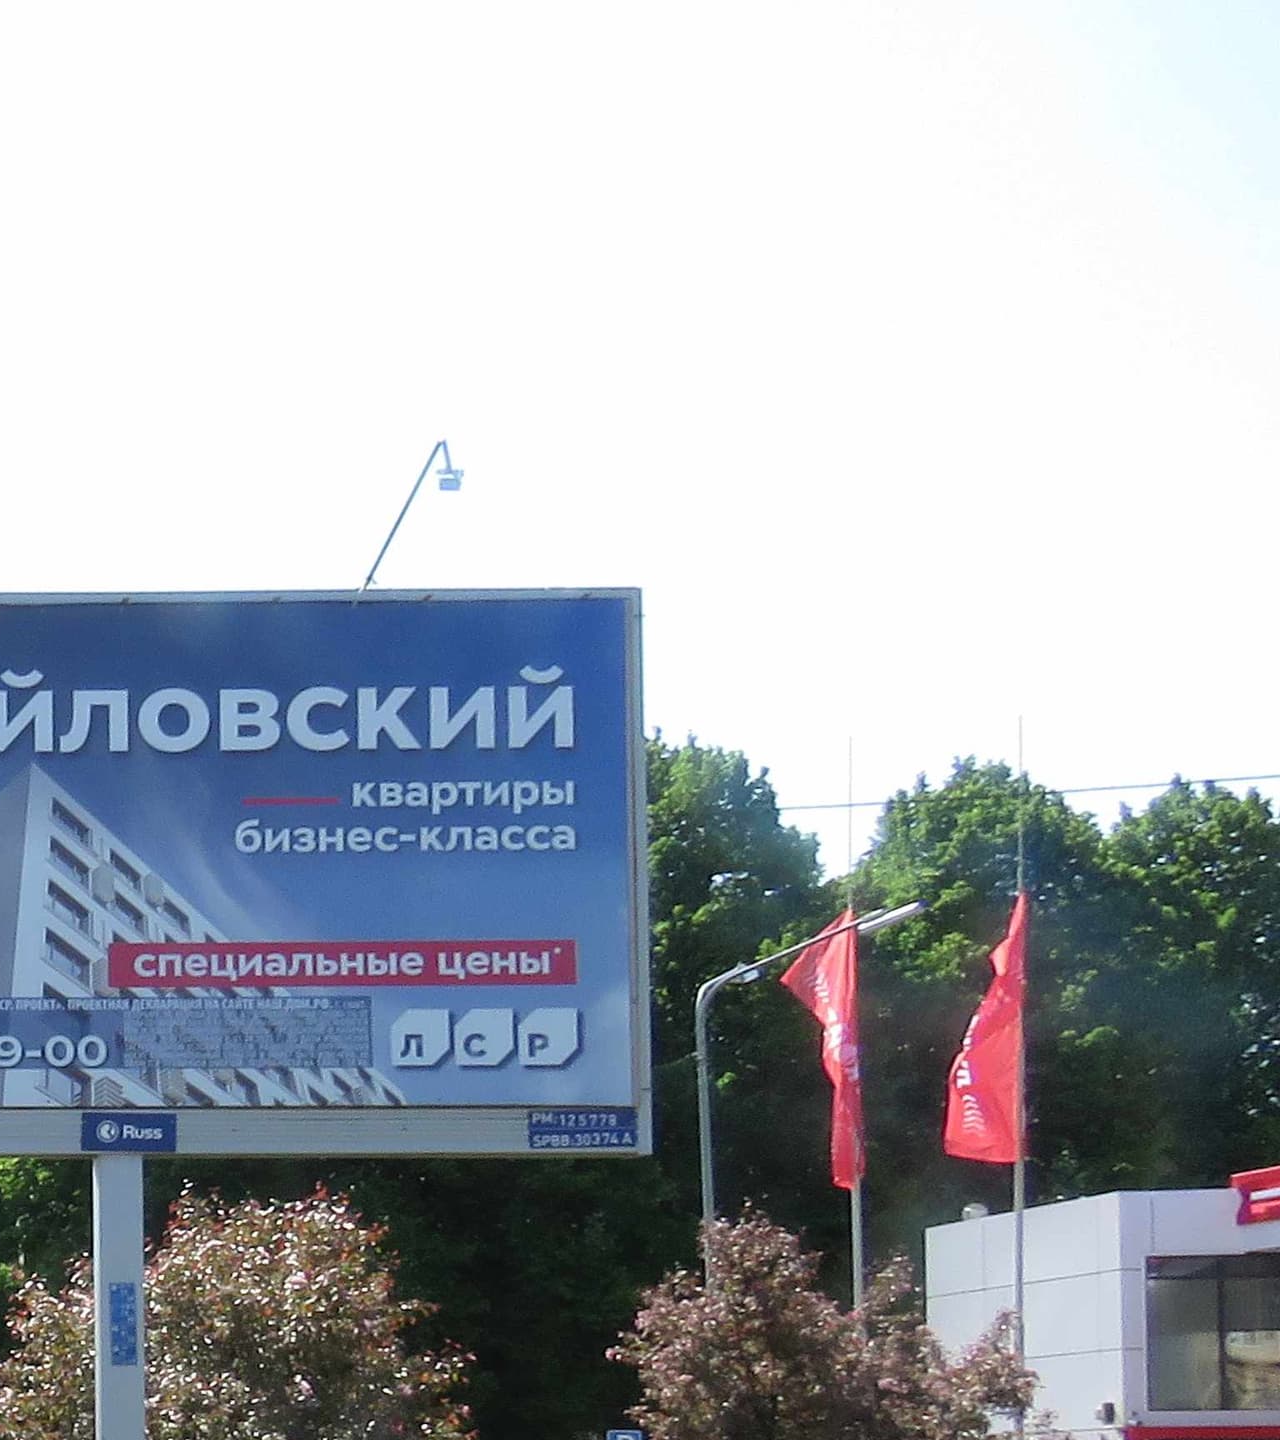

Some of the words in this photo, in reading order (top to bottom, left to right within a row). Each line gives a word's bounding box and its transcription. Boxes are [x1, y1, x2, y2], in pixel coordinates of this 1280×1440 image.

[351, 779, 575, 814] квартиры
[234, 818, 577, 853] бизнес-класса
[133, 948, 425, 982] специальные
[122, 1124, 163, 1140] Russ
